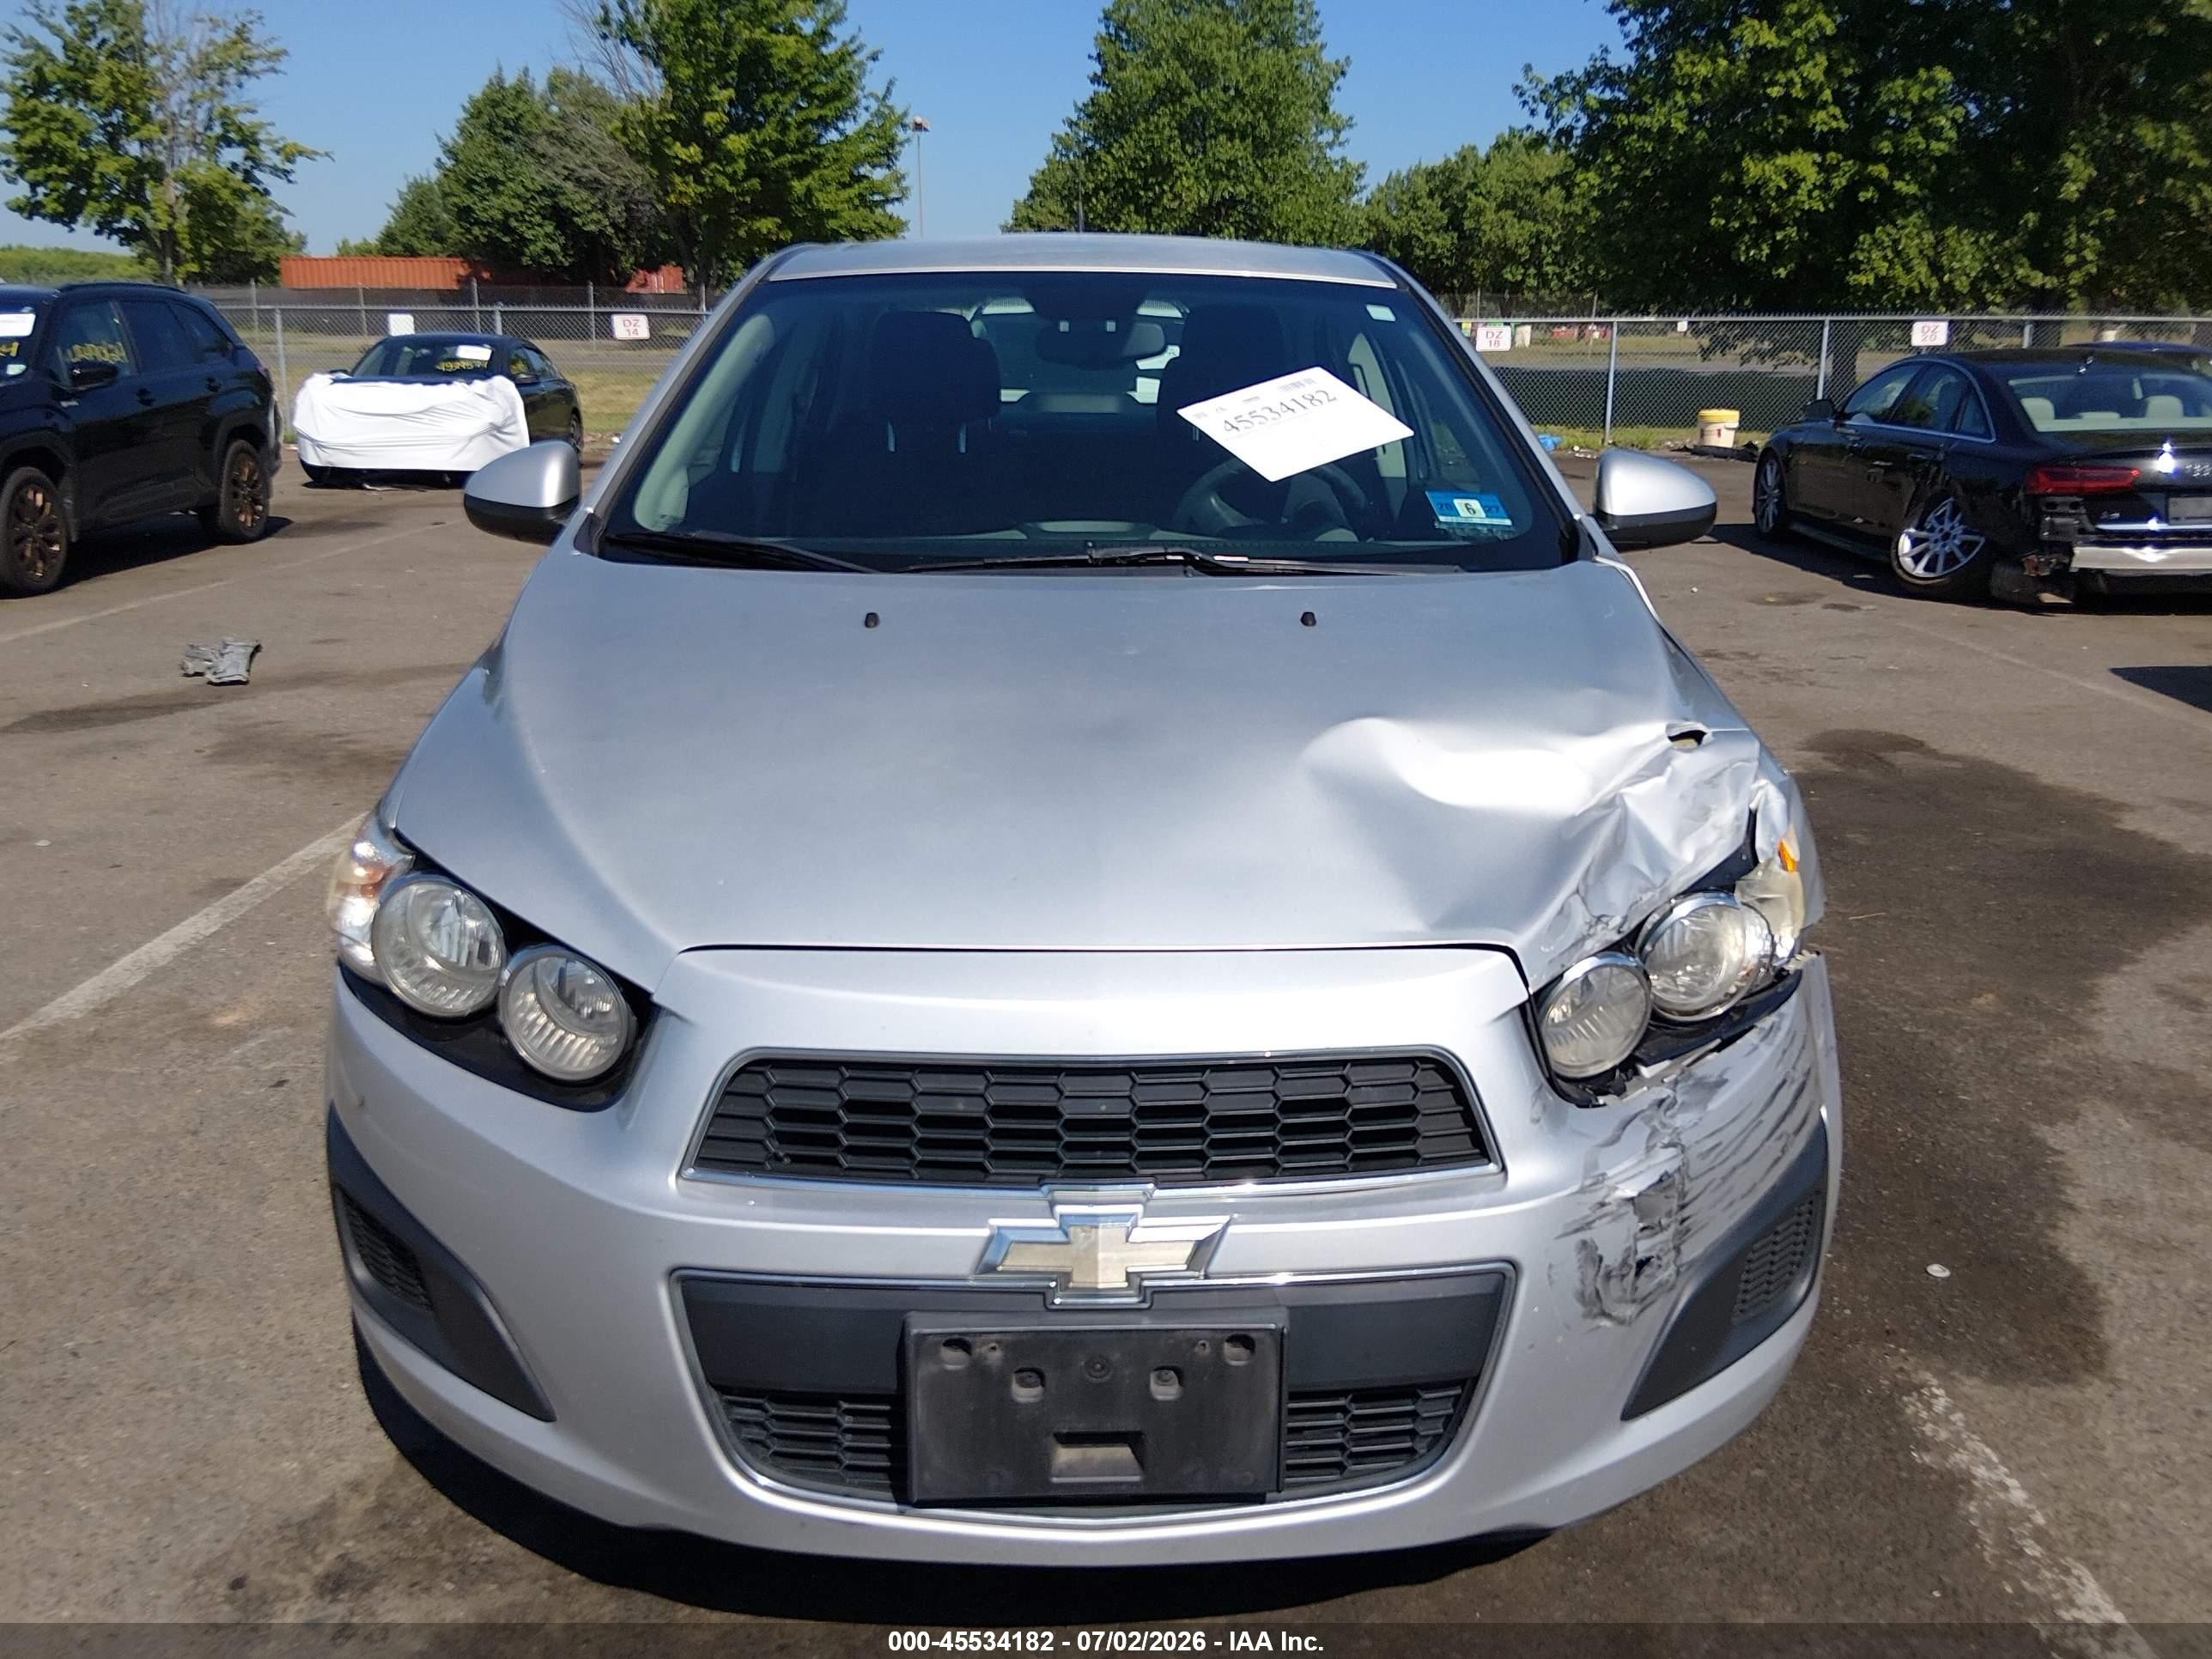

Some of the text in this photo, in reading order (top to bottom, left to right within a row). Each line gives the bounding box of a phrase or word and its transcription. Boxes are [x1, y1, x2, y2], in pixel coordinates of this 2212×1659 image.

[623, 319, 641, 328] DZ
[626, 328, 640, 337] 14
[1486, 331, 1504, 339] DZ
[1489, 339, 1500, 348] 18
[1223, 389, 1338, 433] 45534182
[1464, 502, 1476, 516] 6
